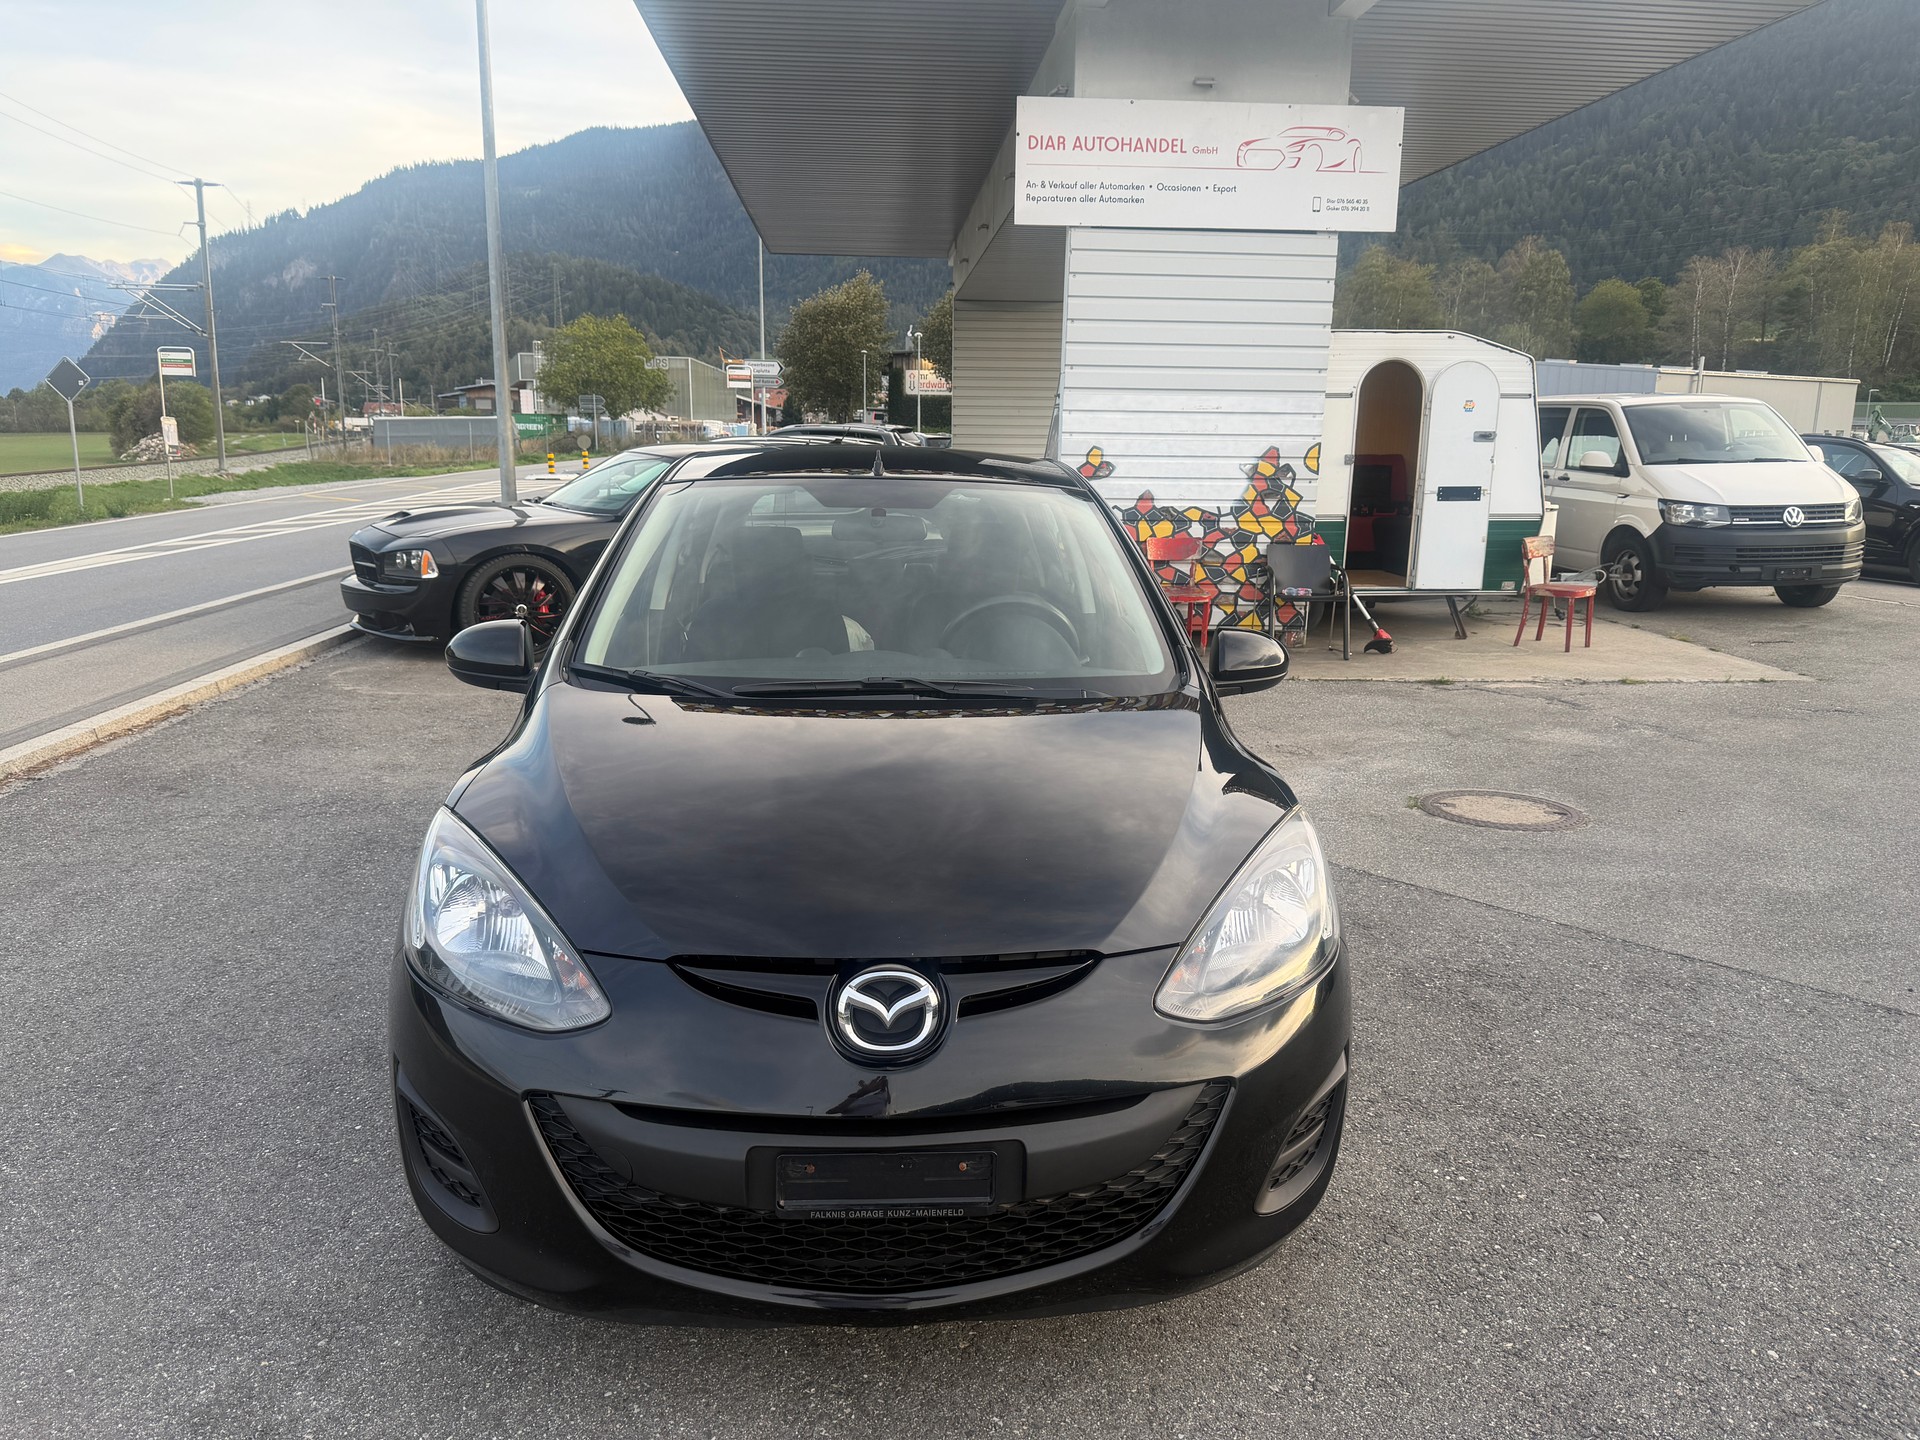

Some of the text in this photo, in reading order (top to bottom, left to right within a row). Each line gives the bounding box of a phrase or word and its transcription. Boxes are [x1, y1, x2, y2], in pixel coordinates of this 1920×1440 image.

[1027, 134, 1218, 155] DIAR AUTOHANDEL GmbH
[1025, 180, 1237, 195] An- & Verkauf aller Automarken Occasionen Export
[1025, 193, 1145, 204] Reparaturen aller Automarken
[810, 1208, 964, 1219] FALKNIS GARAGE KUNZ-MAIENFELD
